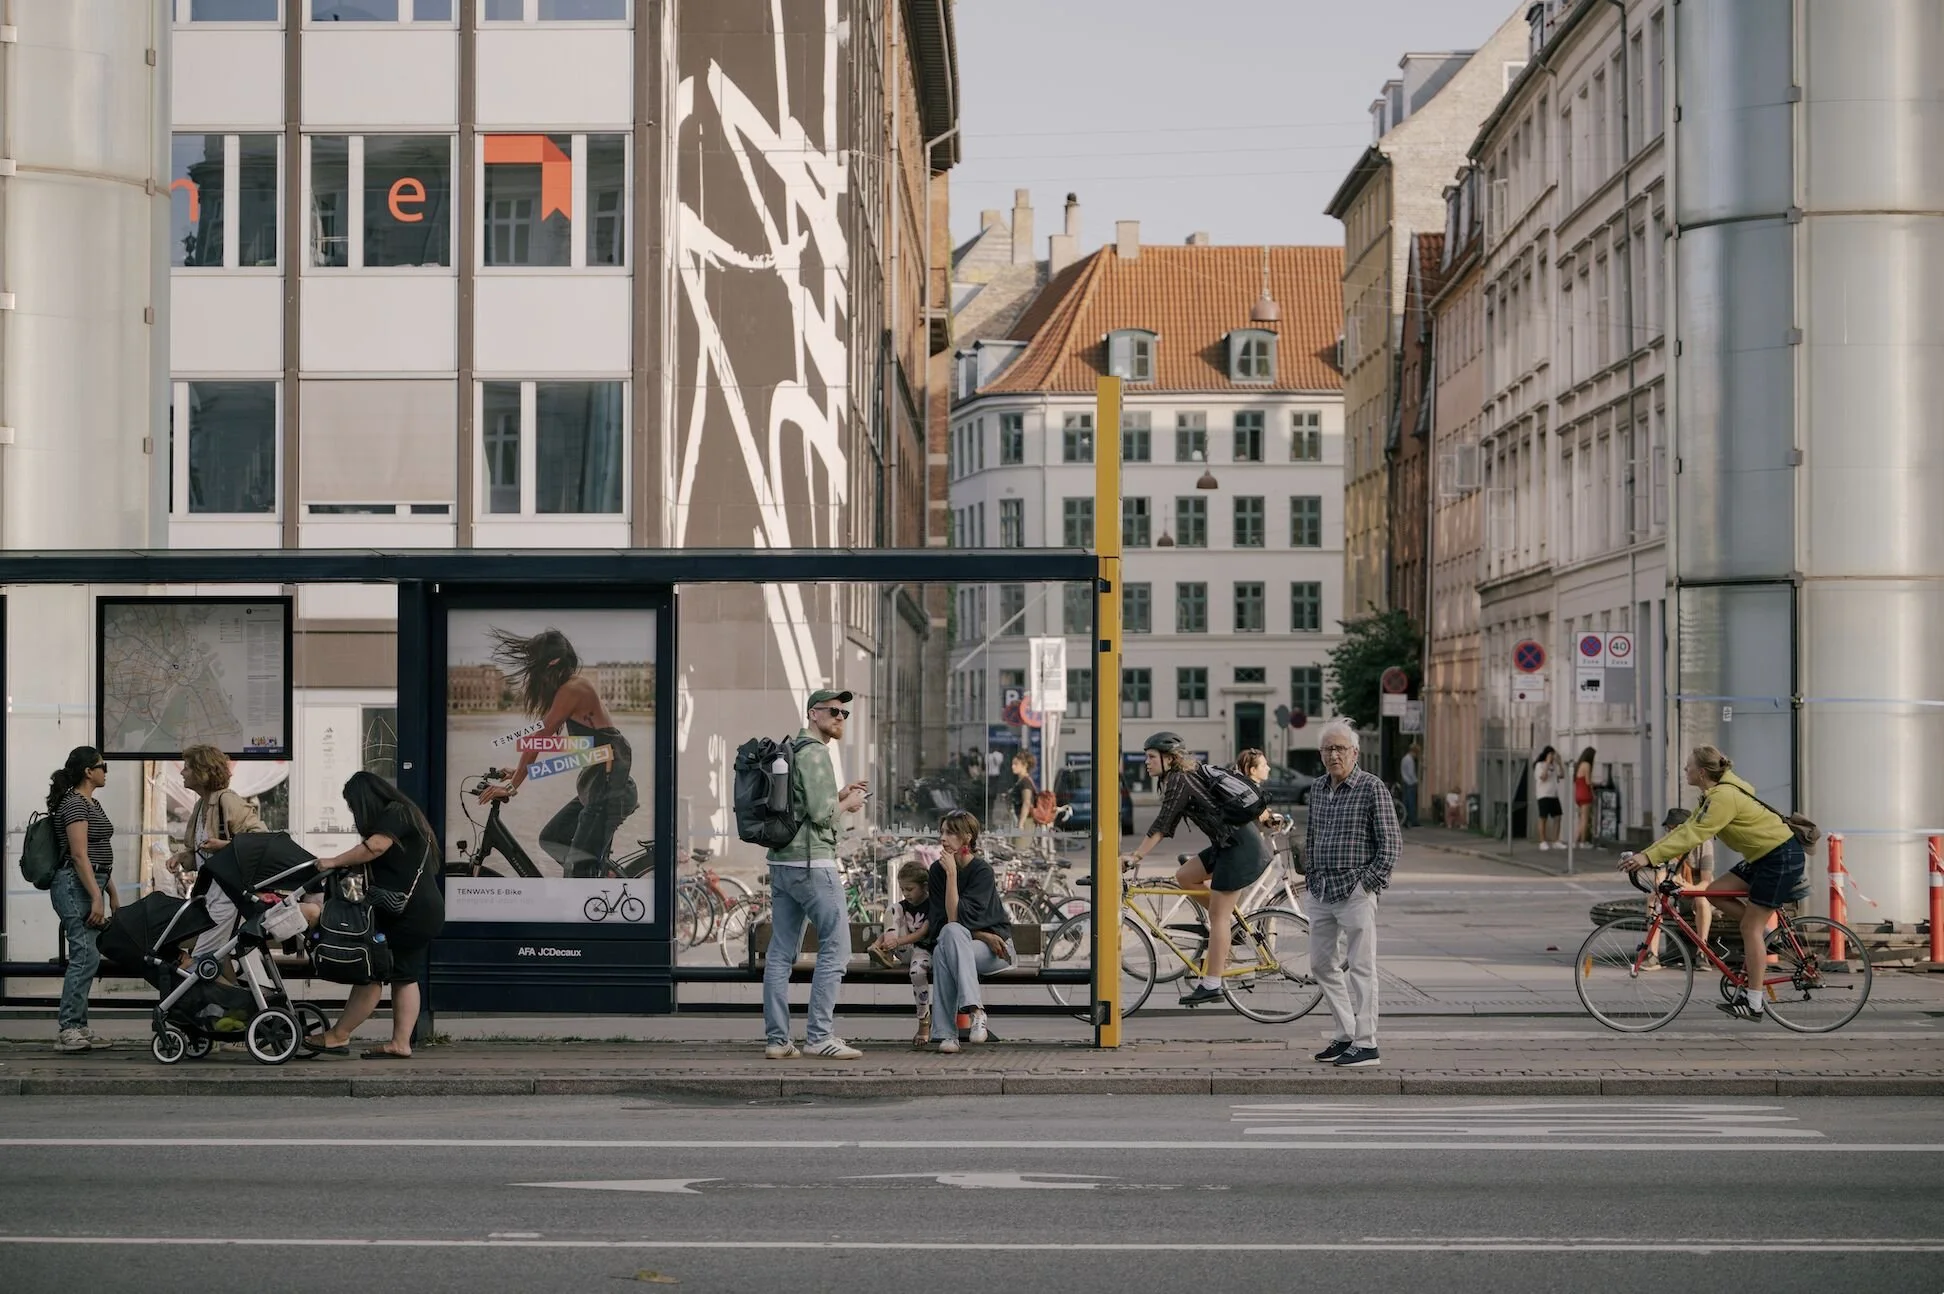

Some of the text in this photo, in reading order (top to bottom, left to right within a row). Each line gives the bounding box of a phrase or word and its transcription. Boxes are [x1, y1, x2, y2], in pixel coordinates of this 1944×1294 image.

[388, 176, 426, 223] e
[1612, 641, 1627, 651] 40
[492, 721, 544, 747] TENWAYS
[520, 737, 590, 750] MEDVIND
[530, 747, 609, 778] PÅ DIN VEJ
[457, 888, 522, 896] TENWAYS E-Bike
[518, 946, 582, 957] AFA JCDecaux
